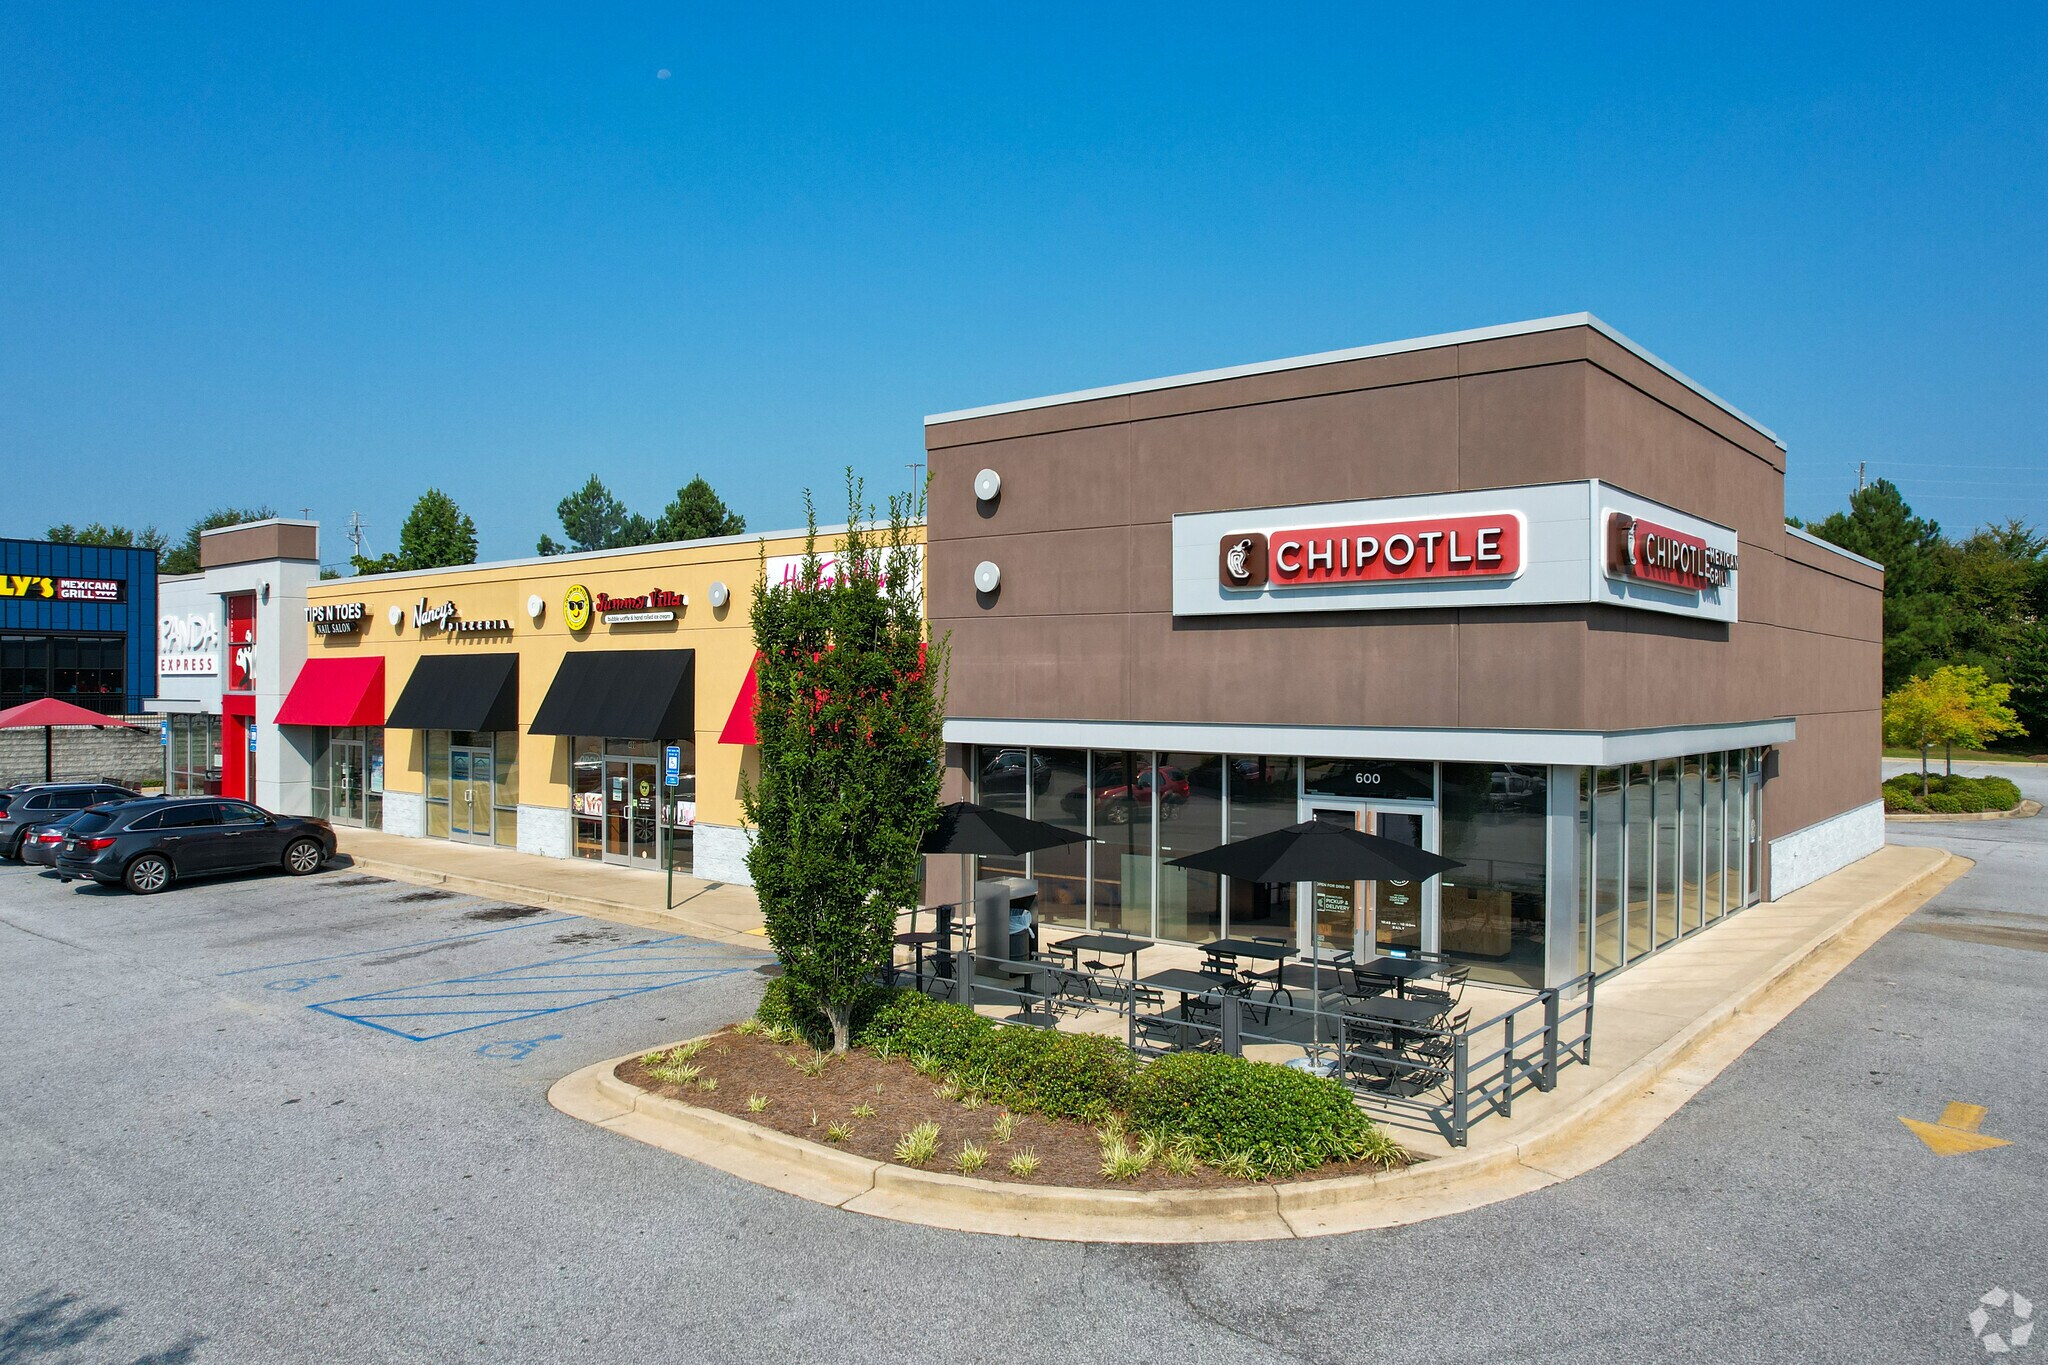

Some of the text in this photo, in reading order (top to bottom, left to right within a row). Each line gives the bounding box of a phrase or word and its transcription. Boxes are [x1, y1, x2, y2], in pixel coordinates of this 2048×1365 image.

[1277, 528, 1502, 572] CHIPOTLE
[1647, 533, 1710, 578] CHIPOTLE
[1709, 547, 1739, 570] MEXICAN
[61, 580, 117, 590] MEXICANA
[1710, 567, 1729, 588] GRILL
[61, 590, 94, 599] GRILL
[649, 589, 682, 607] Villa
[304, 603, 361, 622] TIPS N TOES
[413, 597, 454, 630] Nancy's
[160, 612, 218, 653] PANDA
[317, 623, 351, 633] NAIL SALON
[449, 620, 506, 631] PIZZERIA
[161, 658, 212, 671] EXPRESS
[1355, 772, 1381, 784] 600
[1326, 903, 1350, 911] DELIVERY
